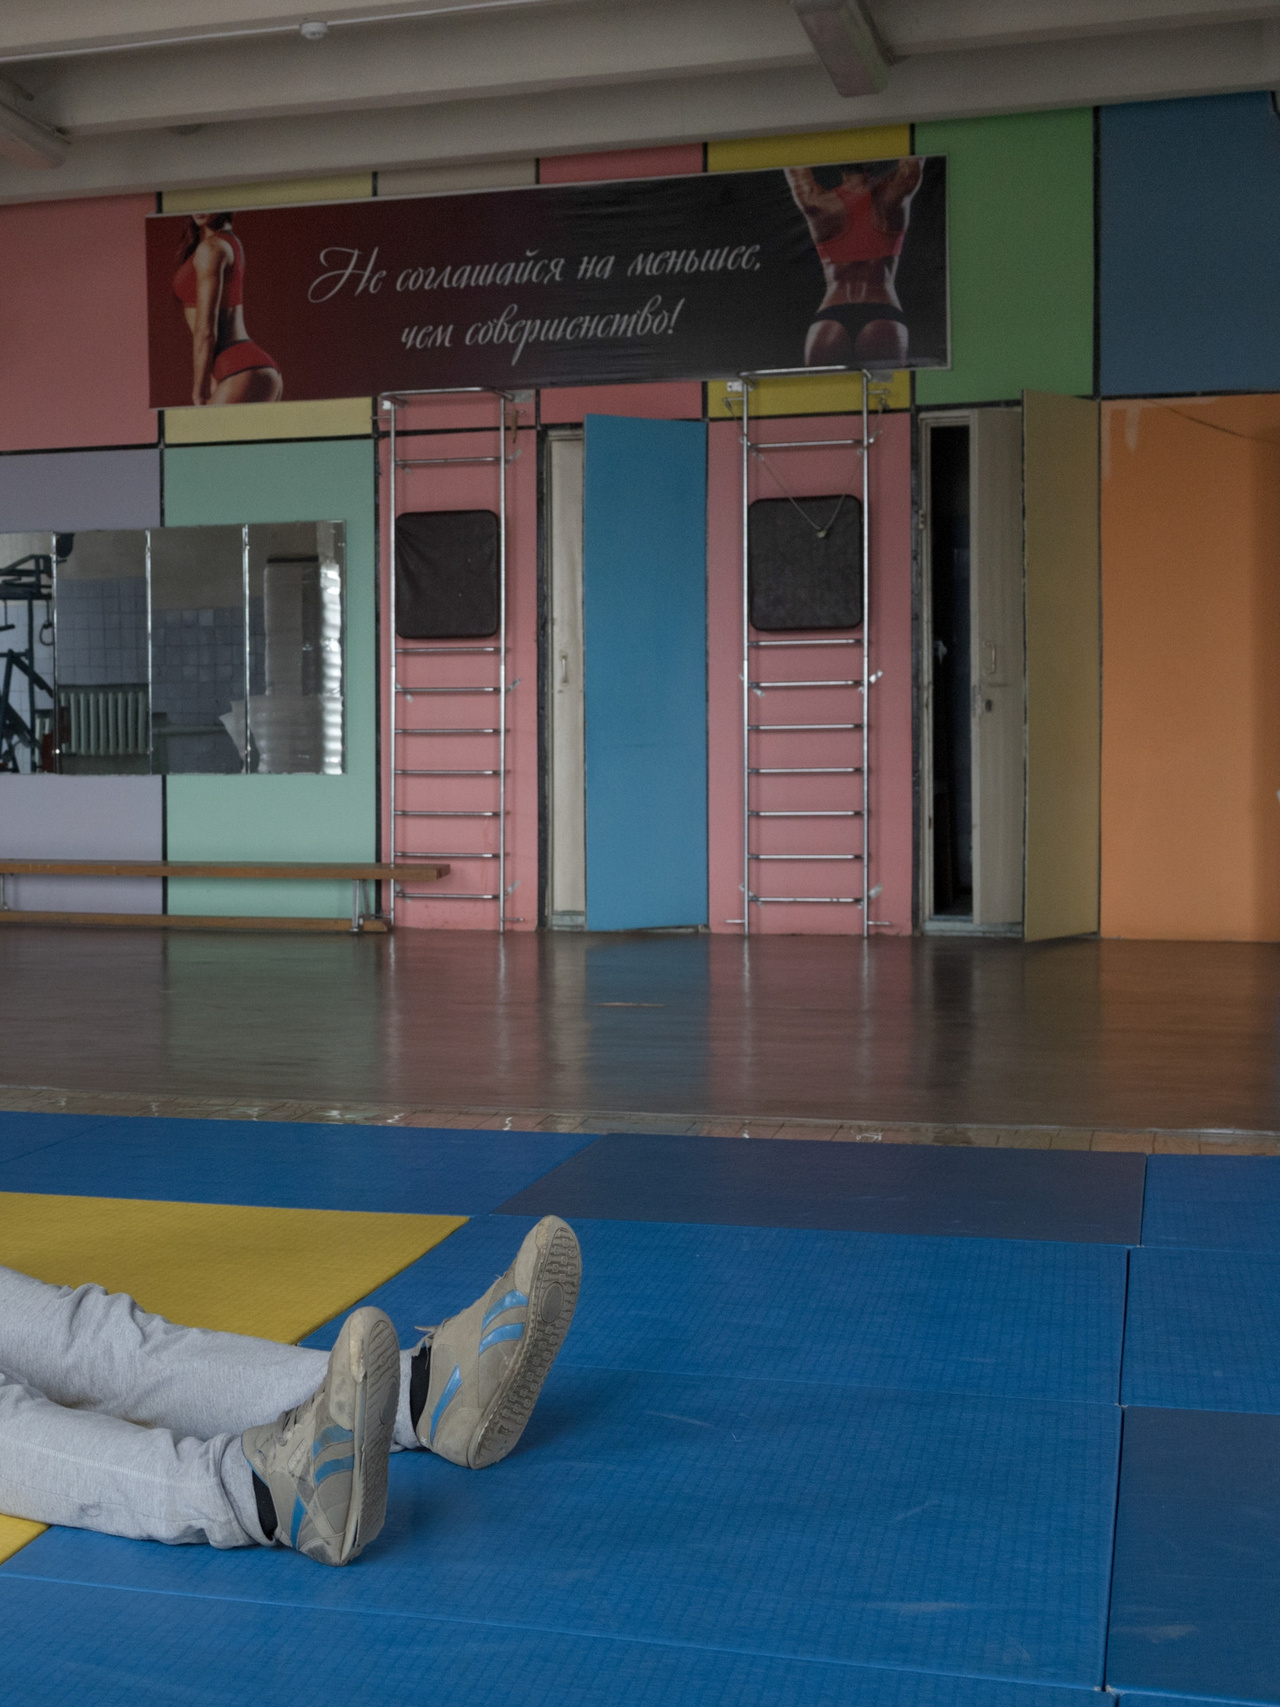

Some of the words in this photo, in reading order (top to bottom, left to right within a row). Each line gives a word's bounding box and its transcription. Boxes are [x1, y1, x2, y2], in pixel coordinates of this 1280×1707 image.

[308, 245, 386, 303] Не
[395, 248, 567, 292] соглашайся
[577, 255, 616, 280] на
[627, 243, 761, 278] меньшее,
[401, 323, 454, 351] чем
[465, 294, 686, 367] совершенство!
